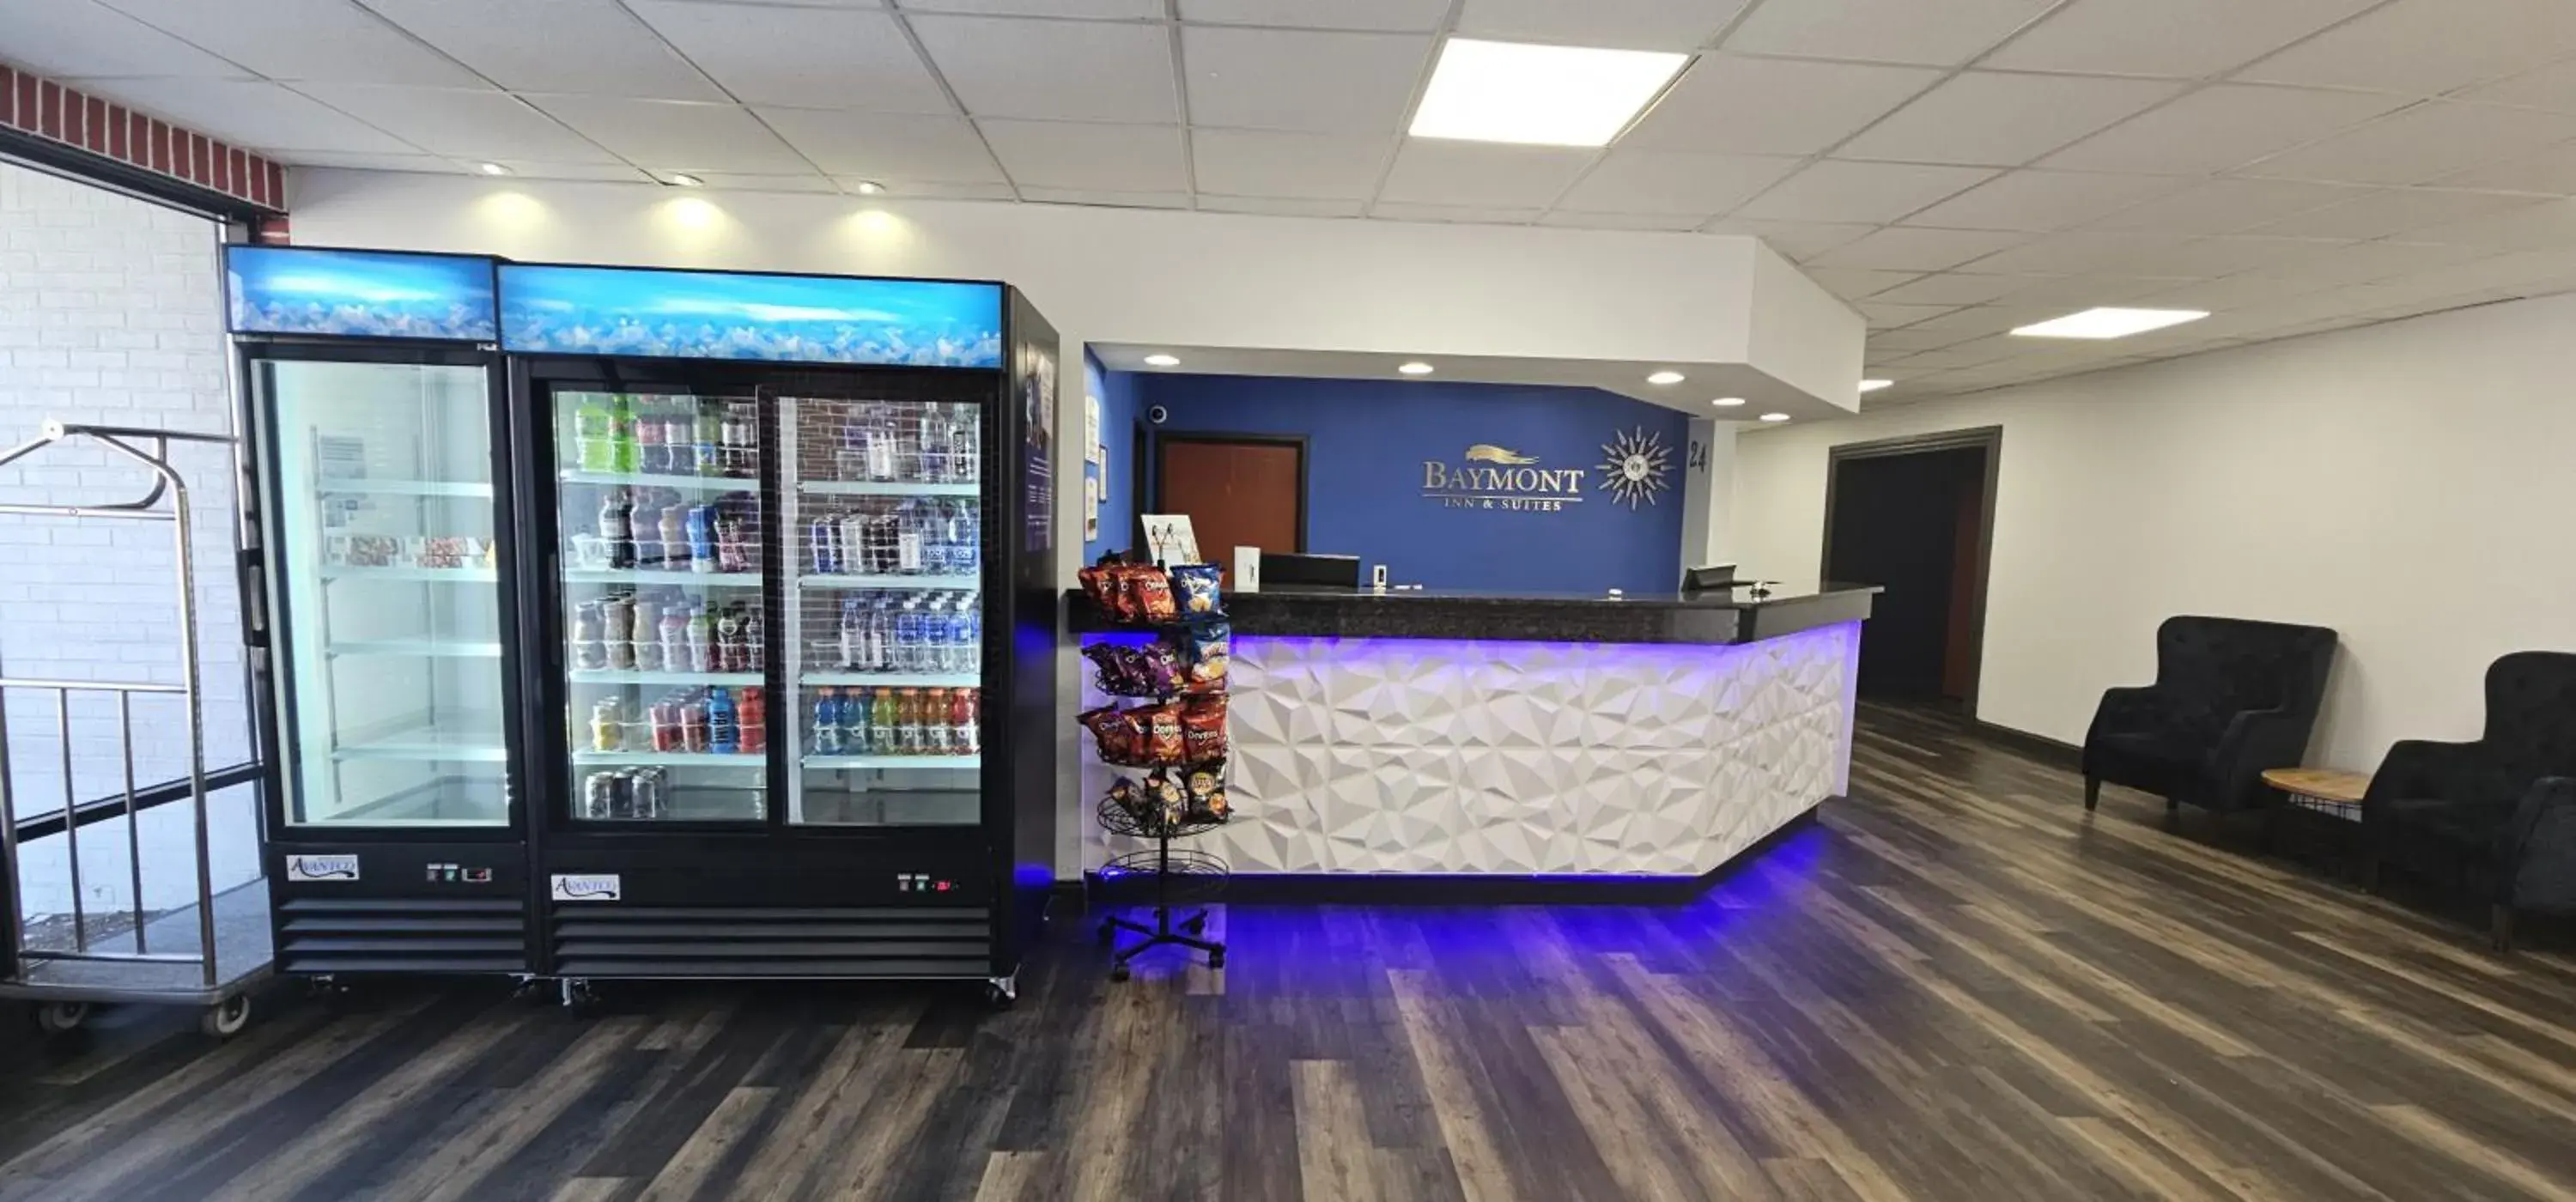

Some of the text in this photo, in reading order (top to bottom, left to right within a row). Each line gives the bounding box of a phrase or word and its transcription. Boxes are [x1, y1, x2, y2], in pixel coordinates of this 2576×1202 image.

[1689, 440, 1706, 473] 24
[1422, 460, 1584, 494] BAYMONT
[1444, 497, 1562, 512] INN & SUITES
